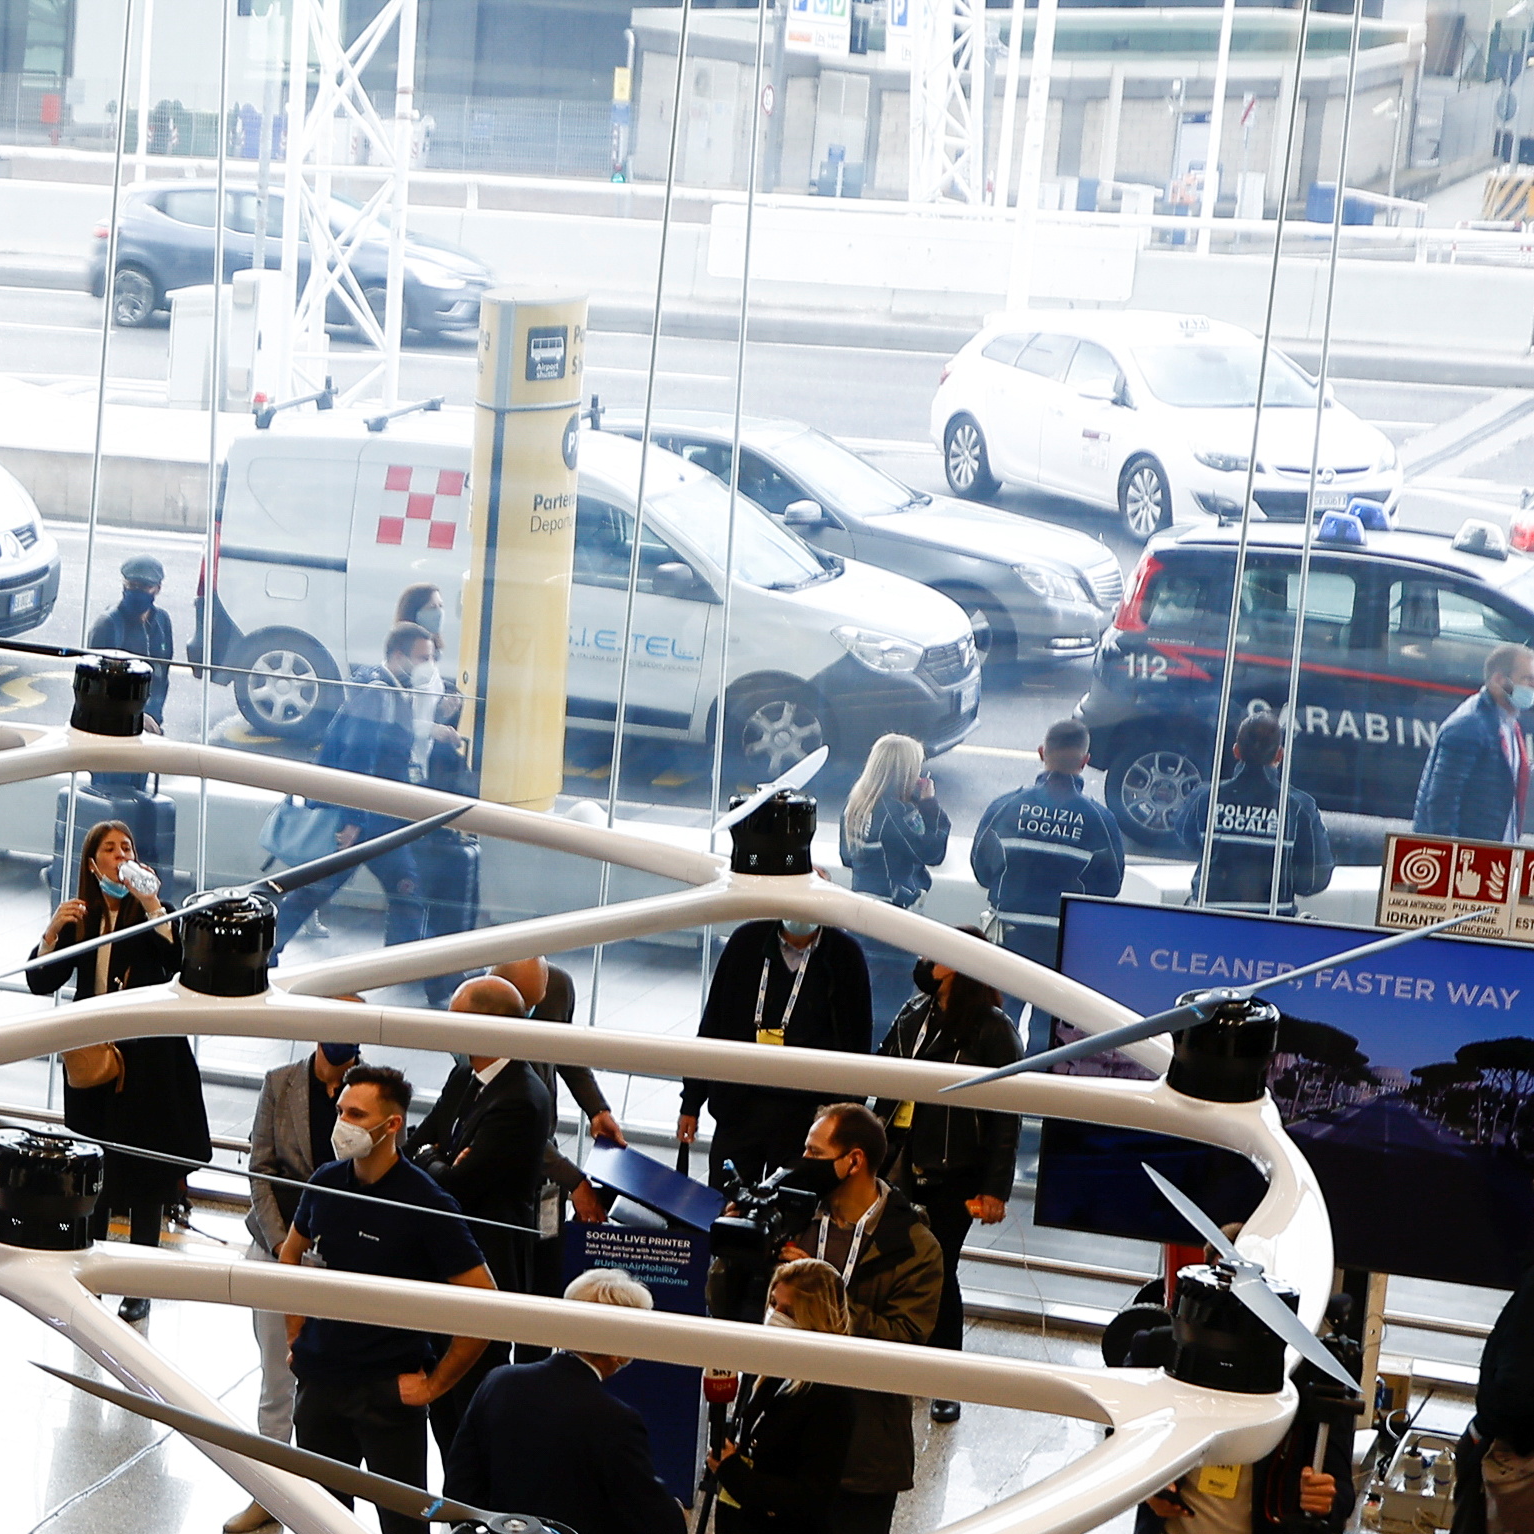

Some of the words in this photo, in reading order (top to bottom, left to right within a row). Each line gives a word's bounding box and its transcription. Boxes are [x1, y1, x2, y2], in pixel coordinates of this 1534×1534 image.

[536, 362, 559, 373] Airport
[536, 370, 558, 379] shuttle
[1124, 654, 1168, 682] 112
[1019, 803, 1084, 825] POLIZIA
[1215, 803, 1278, 822] POLIZIA
[1018, 818, 1083, 841] LOCALE
[1215, 816, 1278, 834] LOCALE
[1117, 945, 1139, 967] A
[1314, 968, 1436, 1001] FASTER
[1446, 980, 1521, 1012] WAY
[586, 1230, 623, 1241] SOCIAL
[624, 1234, 647, 1245] LIVE
[648, 1236, 691, 1249] PRINTER
[601, 1242, 612, 1250] the
[613, 1244, 635, 1253] picture
[636, 1246, 650, 1254] with
[602, 1250, 622, 1258] forget
[593, 1259, 679, 1275] #UrbanAirMobility
